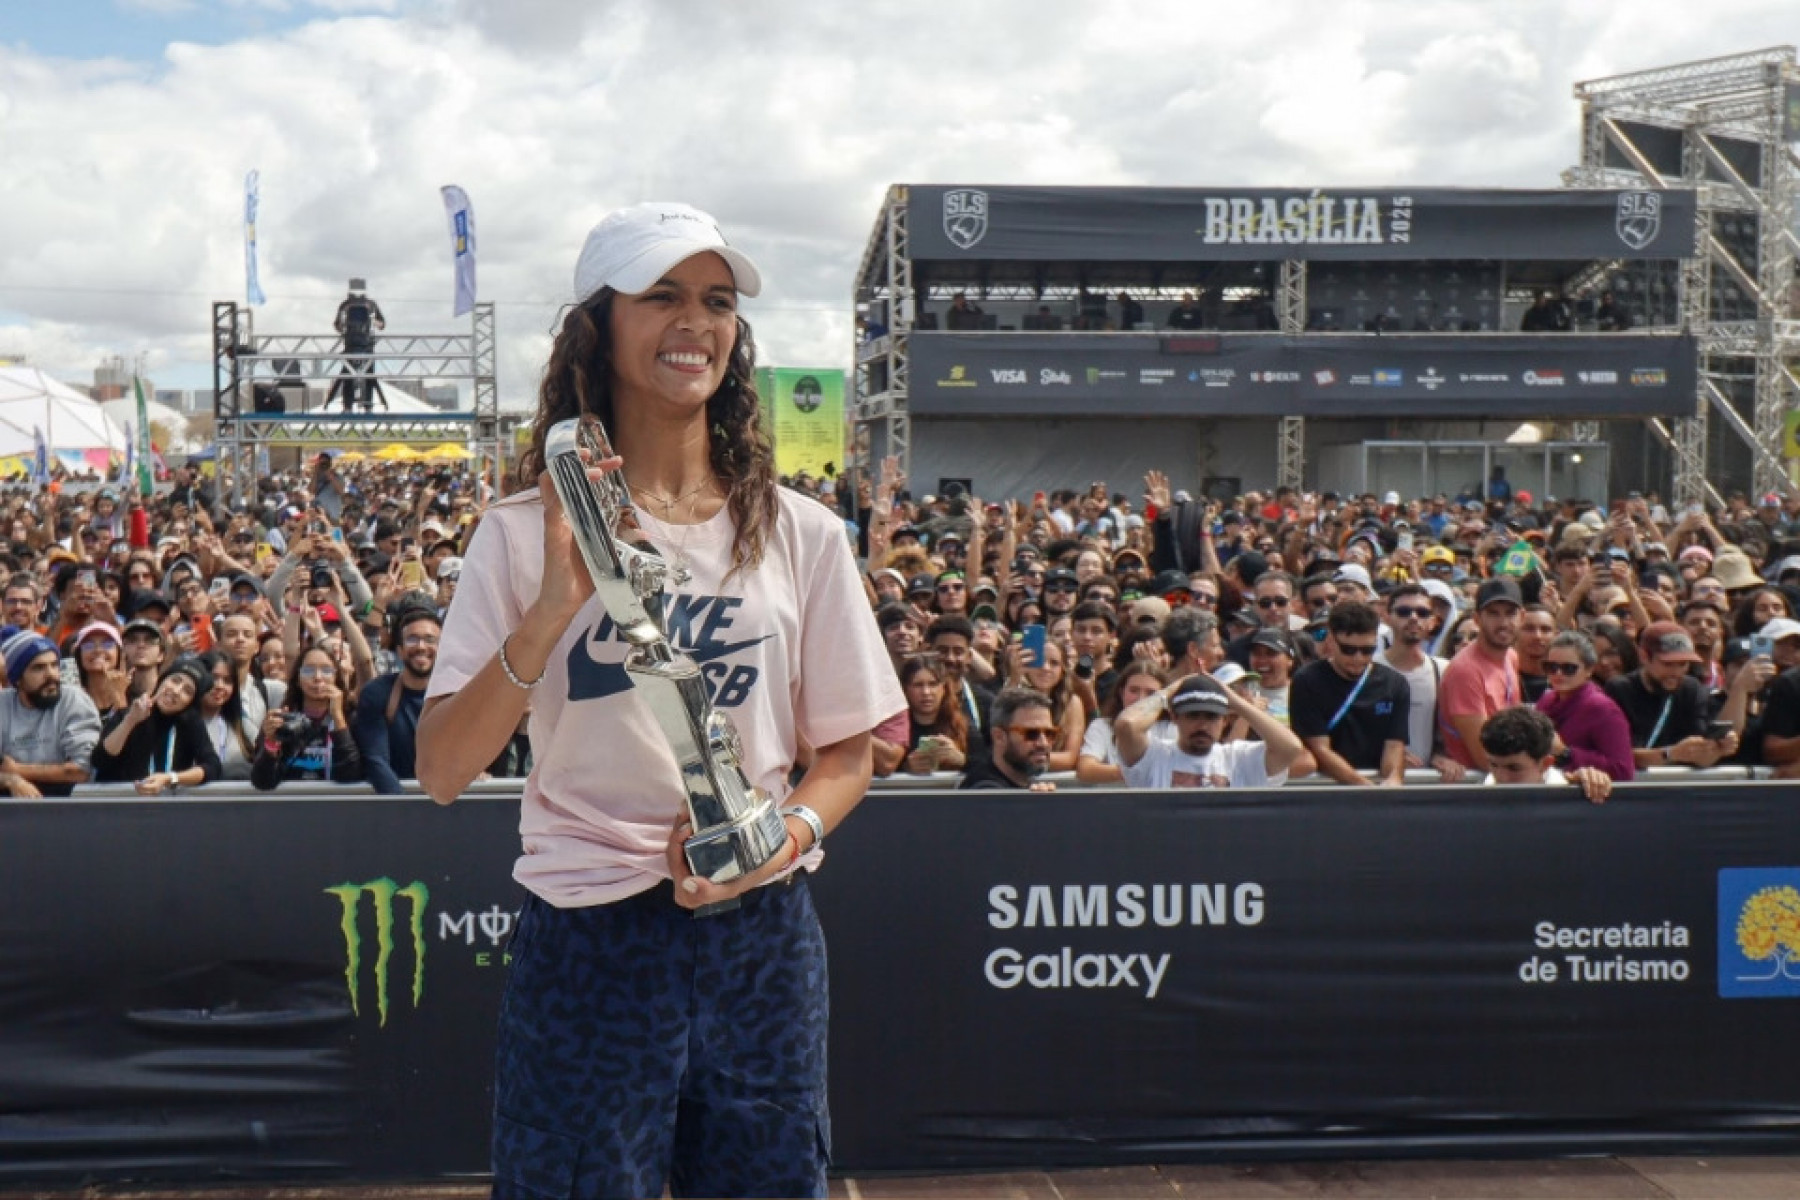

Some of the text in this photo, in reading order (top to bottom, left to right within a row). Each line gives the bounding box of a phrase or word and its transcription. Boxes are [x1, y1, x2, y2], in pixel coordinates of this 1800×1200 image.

[947, 193, 985, 214] SLS
[1204, 188, 1413, 244] BRASÍLIA 2025
[1621, 195, 1658, 214] SLS
[990, 369, 1027, 384] VISA
[593, 593, 743, 649] KE
[701, 662, 758, 707] SB
[987, 883, 1265, 929] SAMSUNG
[1534, 920, 1690, 948] Secretaria
[984, 946, 1171, 998] Galaxy
[1518, 954, 1690, 982] de Turismo
